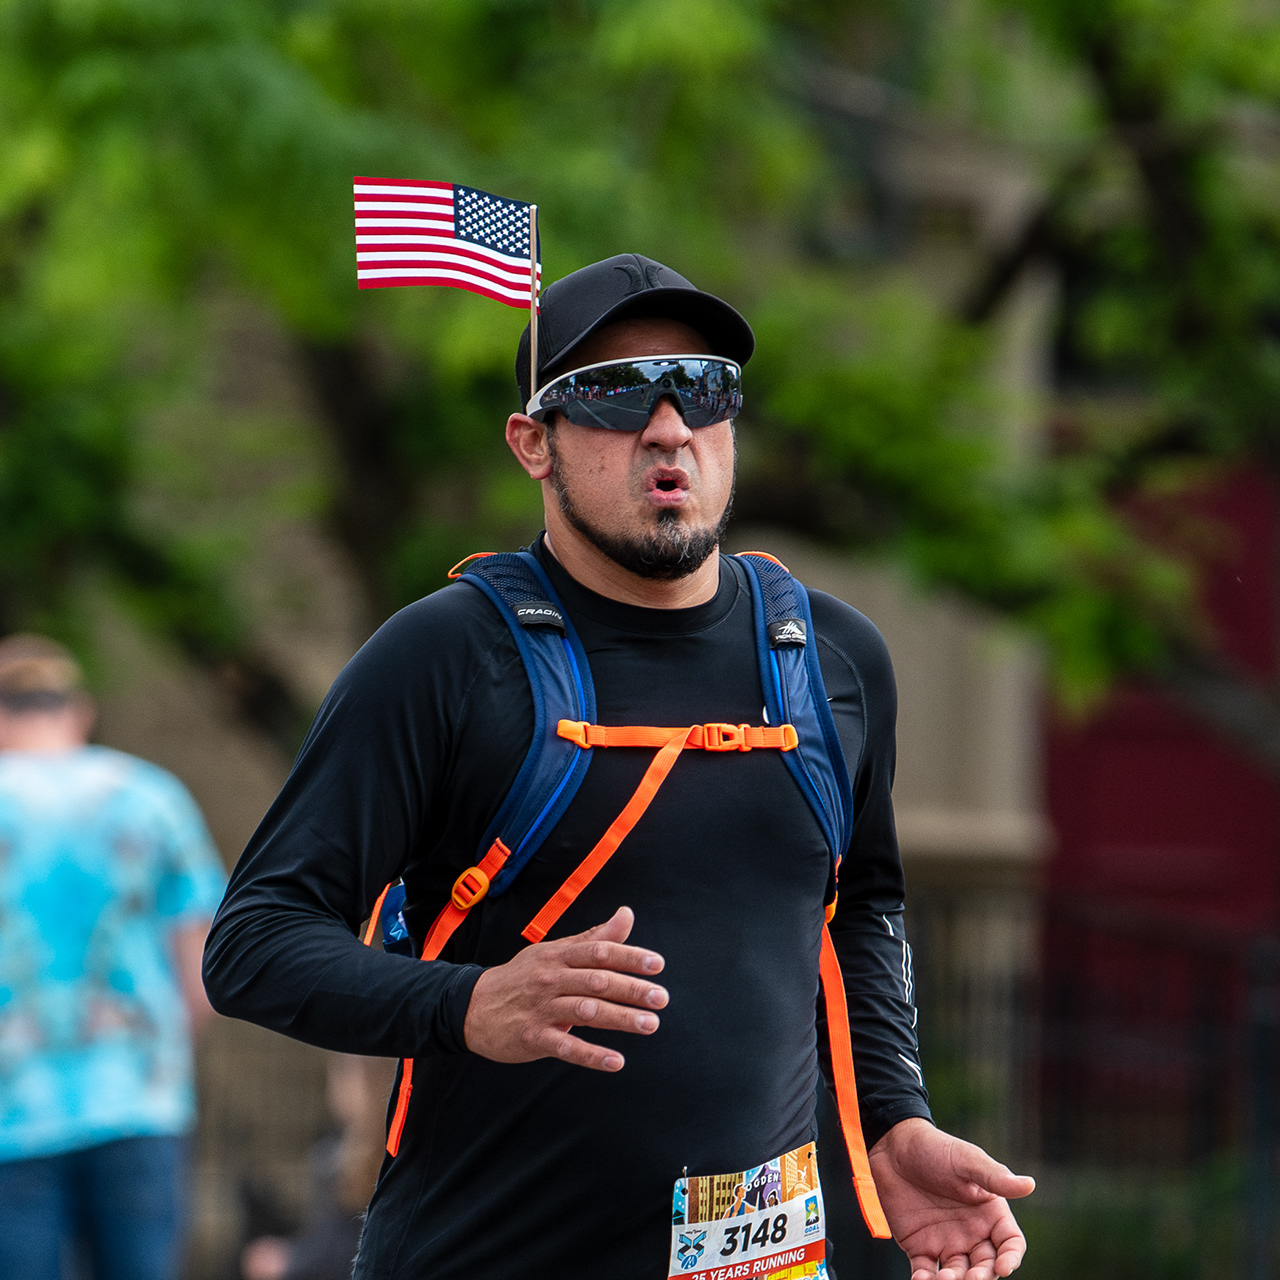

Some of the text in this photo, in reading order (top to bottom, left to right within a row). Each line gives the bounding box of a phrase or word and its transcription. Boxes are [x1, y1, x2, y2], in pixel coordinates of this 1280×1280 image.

[745, 1172, 780, 1192] OGDEN
[720, 1213, 788, 1257] 3148
[752, 1248, 805, 1274] RUNNING
